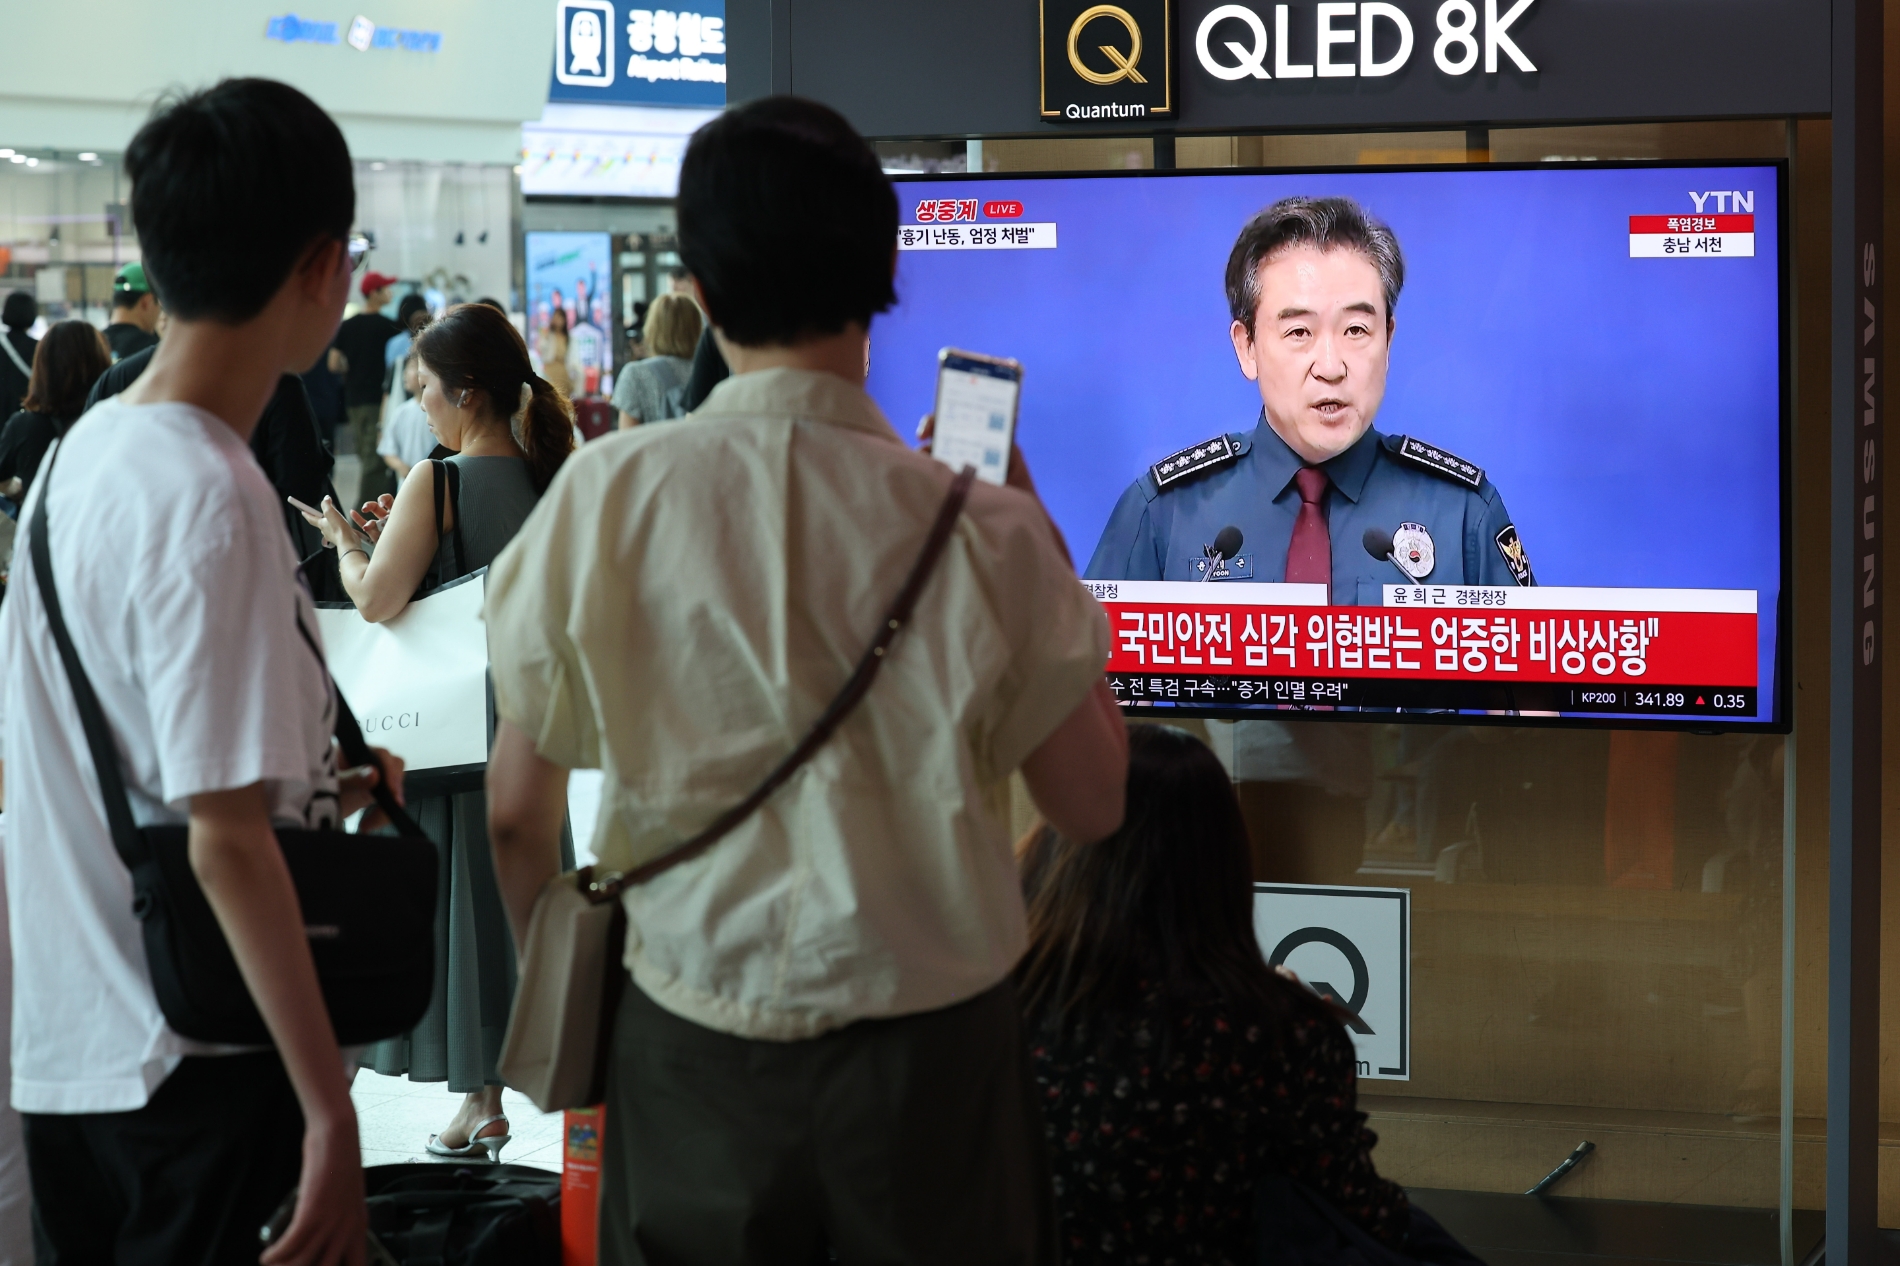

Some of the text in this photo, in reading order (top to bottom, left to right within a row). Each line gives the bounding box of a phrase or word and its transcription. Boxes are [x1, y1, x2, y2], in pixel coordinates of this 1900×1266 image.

[1067, 4, 1148, 86] Q
[1195, 0, 1538, 80] QLED 8K
[1065, 102, 1146, 120] Quantum
[916, 199, 978, 222] 생중계
[989, 204, 1017, 214] LIVE
[1688, 190, 1754, 213] YTN
[1667, 217, 1717, 232] 폭염경보
[933, 228, 965, 246] 난동,
[969, 228, 997, 245] 엄정
[1001, 227, 1035, 244] 처벌"
[1662, 237, 1722, 254] 충남 서천
[1863, 242, 1876, 666] SAMSUNG
[1393, 587, 1508, 606] 윤 희 근 경찰청장
[1118, 611, 1233, 665] 국민안전
[1239, 612, 1299, 668] 심각
[1306, 614, 1423, 670] 위협받는
[1430, 616, 1520, 673] 엄중한
[1529, 617, 1659, 677] 비상상황"
[1129, 677, 1145, 696] 전
[1148, 678, 1179, 697] 특검
[1273, 681, 1306, 700] 인멸
[1310, 682, 1349, 701] 우려"
[1581, 692, 1746, 709] KP200 341.89 0.35
[357, 712, 419, 733] UCCI
